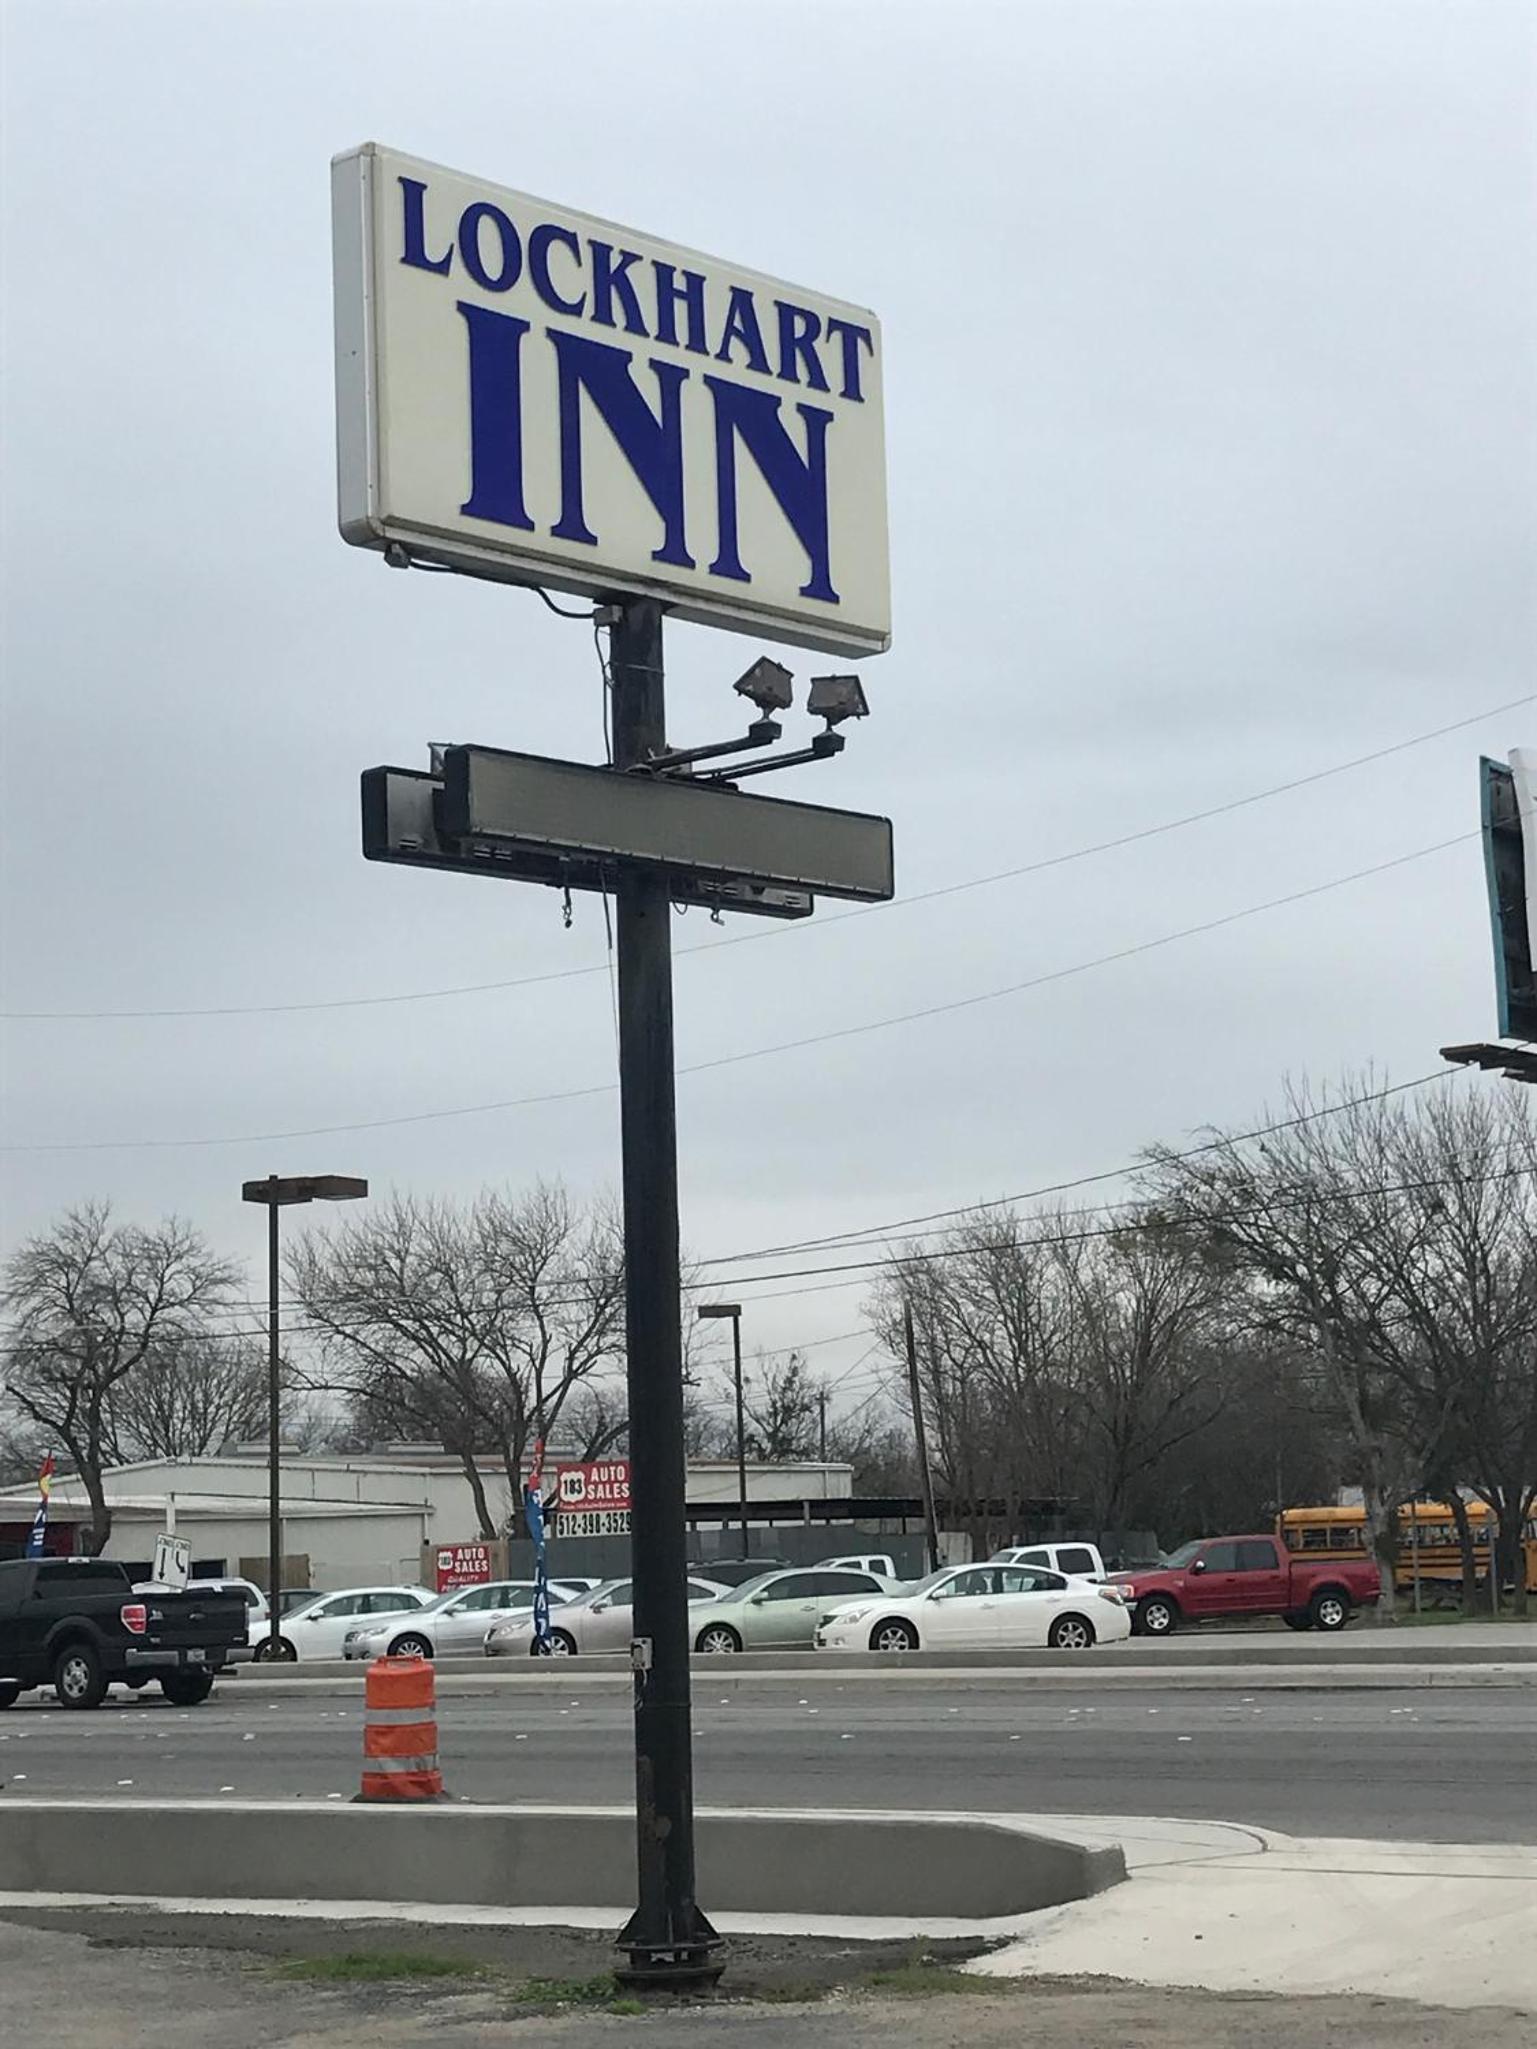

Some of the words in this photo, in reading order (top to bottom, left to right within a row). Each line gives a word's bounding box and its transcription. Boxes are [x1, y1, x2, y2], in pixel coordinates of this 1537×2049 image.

[398, 175, 874, 403] LOCKHART
[456, 300, 840, 605] INN
[590, 1465, 626, 1482] AUTO
[563, 1478, 583, 1496] 183
[586, 1482, 631, 1500] SALES
[457, 1547, 485, 1560] AUTO
[454, 1560, 488, 1573] SALES
